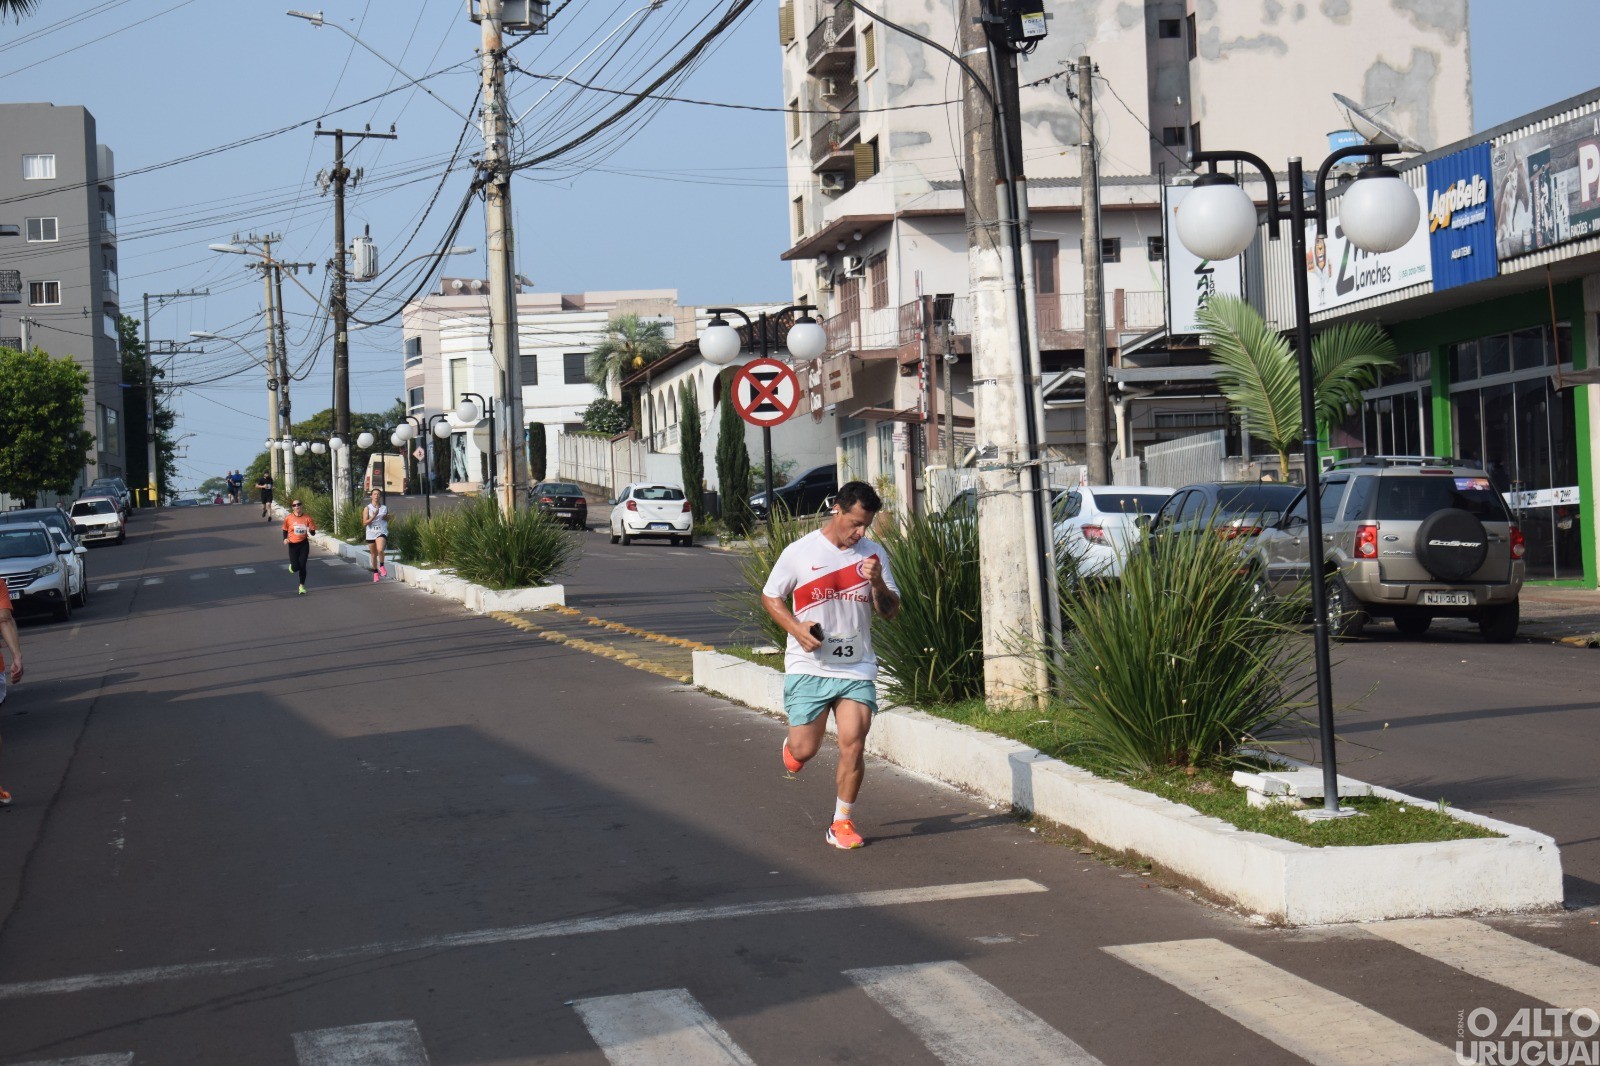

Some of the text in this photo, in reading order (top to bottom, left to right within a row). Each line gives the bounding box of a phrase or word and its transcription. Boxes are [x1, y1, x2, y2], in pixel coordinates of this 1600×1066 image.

[1430, 174, 1487, 225] AgroBella
[1355, 260, 1391, 291] Lanches
[832, 645, 854, 658] 43
